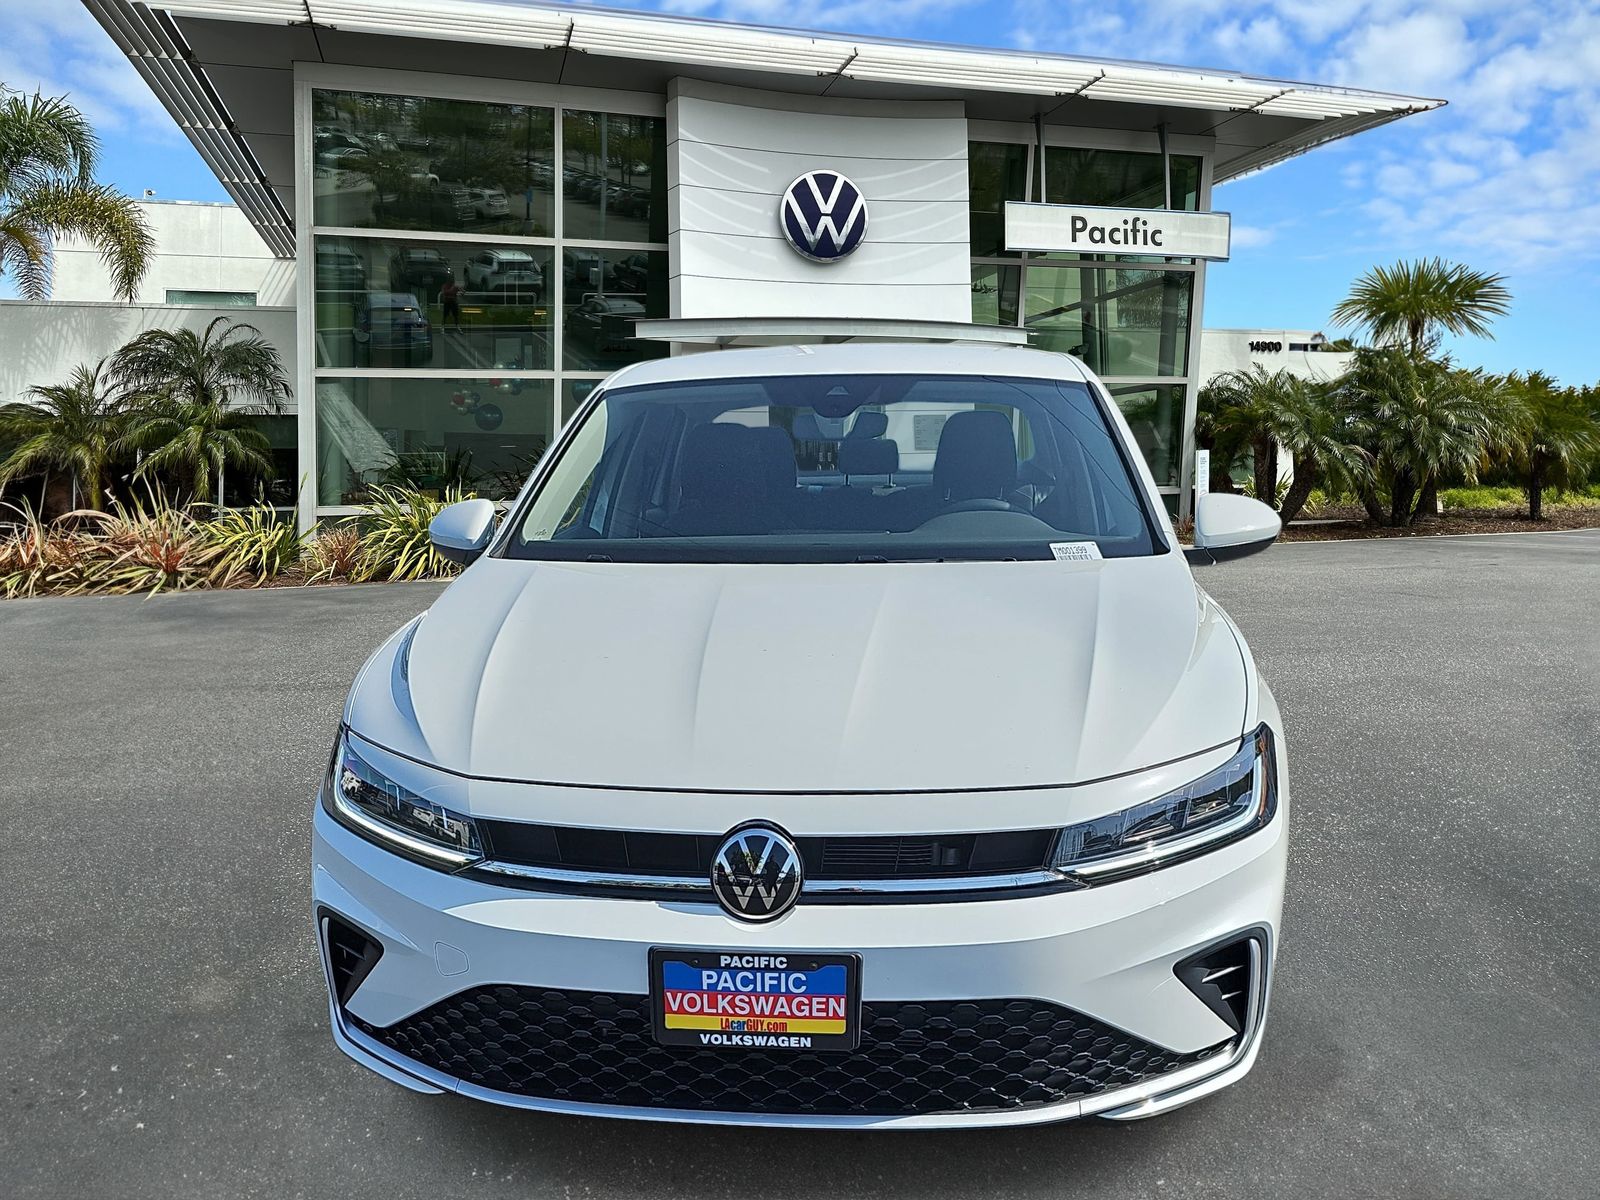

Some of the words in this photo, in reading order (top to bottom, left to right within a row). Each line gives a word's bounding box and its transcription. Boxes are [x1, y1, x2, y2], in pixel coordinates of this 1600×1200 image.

[780, 169, 869, 264] VW
[1071, 215, 1163, 247] Pacific
[1249, 340, 1282, 353] 14900
[720, 955, 788, 969] PACIFIC
[701, 970, 807, 993] PACIFIC
[666, 992, 845, 1017] VOLKSWAGEN
[720, 1017, 788, 1033] LAcarGUY.com
[699, 1033, 812, 1048] VOLKSWAGEN
